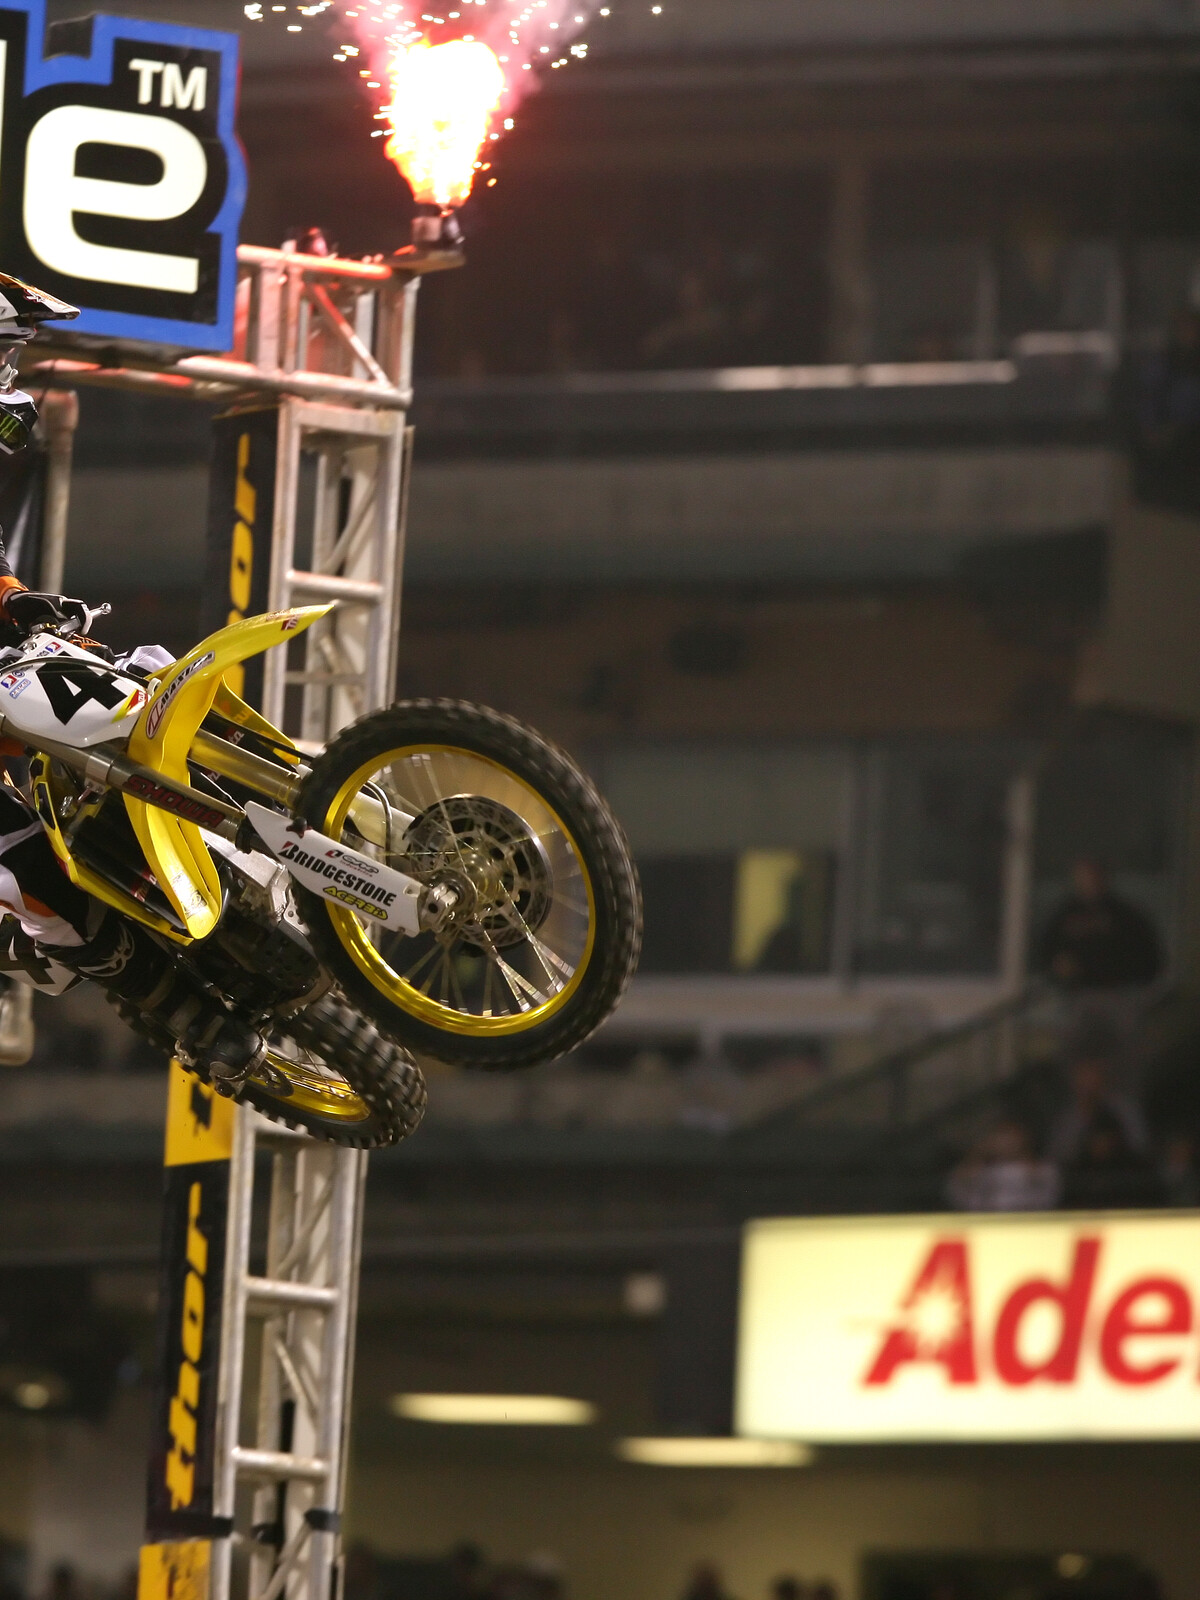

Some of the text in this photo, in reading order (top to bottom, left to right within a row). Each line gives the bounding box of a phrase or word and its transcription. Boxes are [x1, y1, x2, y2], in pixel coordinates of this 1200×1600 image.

[129, 58, 207, 112] TM
[35, 650, 128, 726] 4
[122, 773, 227, 831] SHOWA
[277, 840, 398, 908] BRIDGESTONE
[862, 1236, 1200, 1388] Ade
